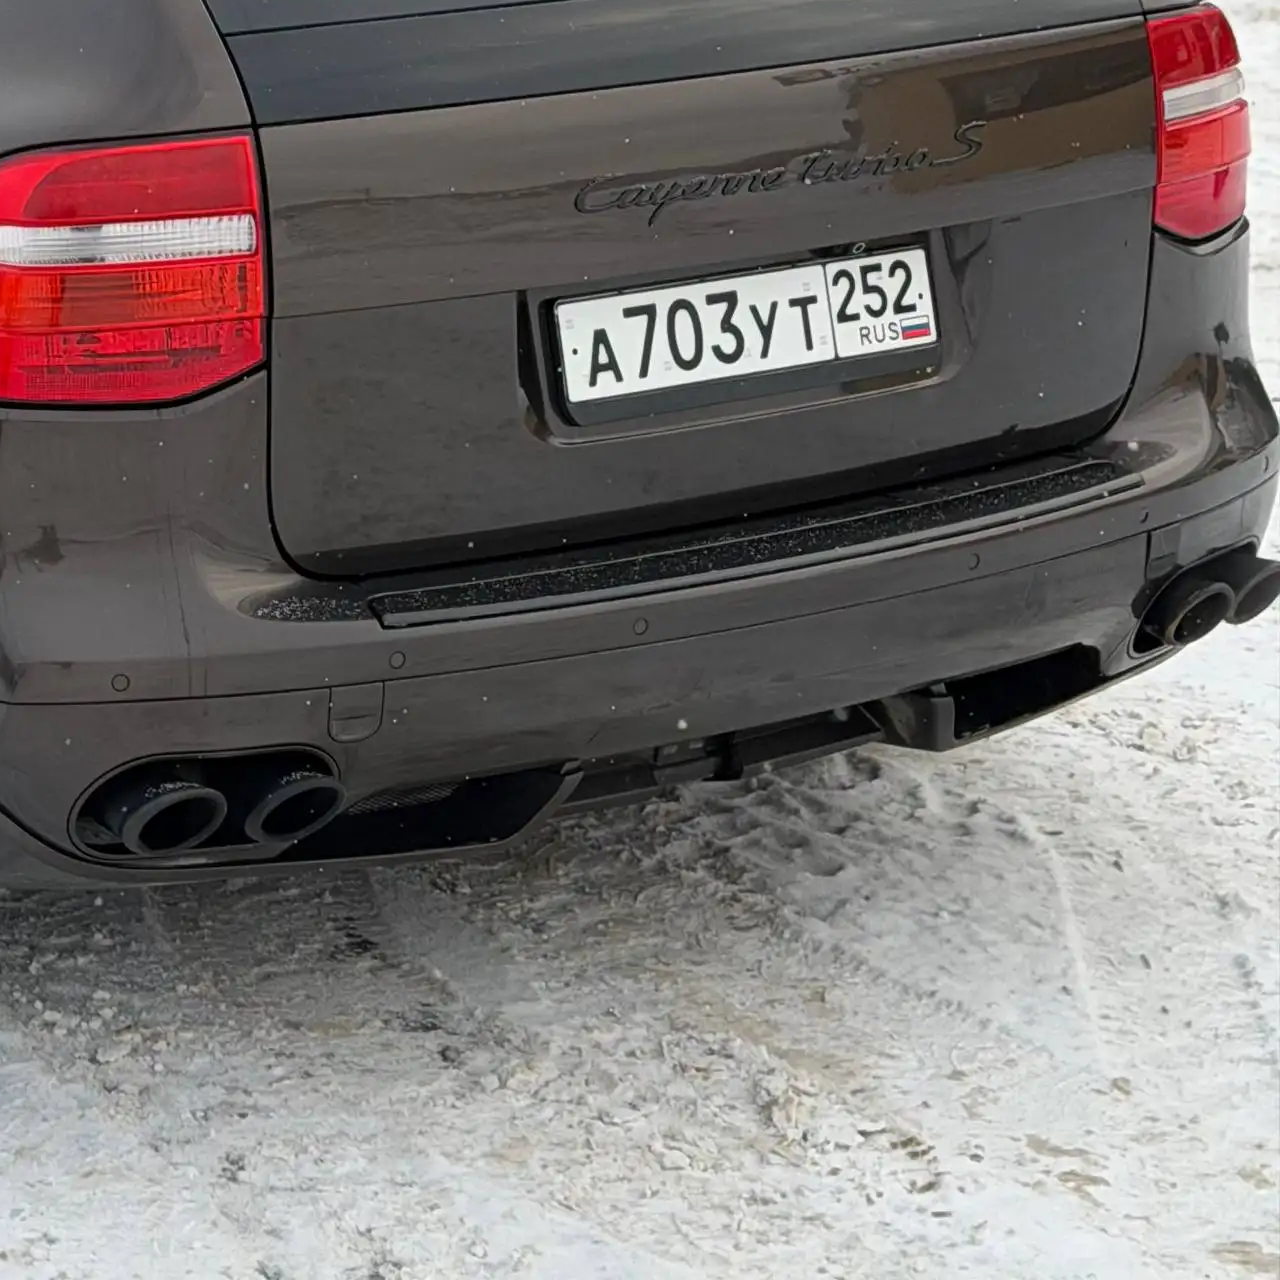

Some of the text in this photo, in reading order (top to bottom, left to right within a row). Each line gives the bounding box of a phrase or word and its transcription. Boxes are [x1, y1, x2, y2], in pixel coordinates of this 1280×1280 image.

[573, 166, 787, 227] Cayenne
[831, 259, 918, 323] 252
[858, 321, 900, 345] RUS
